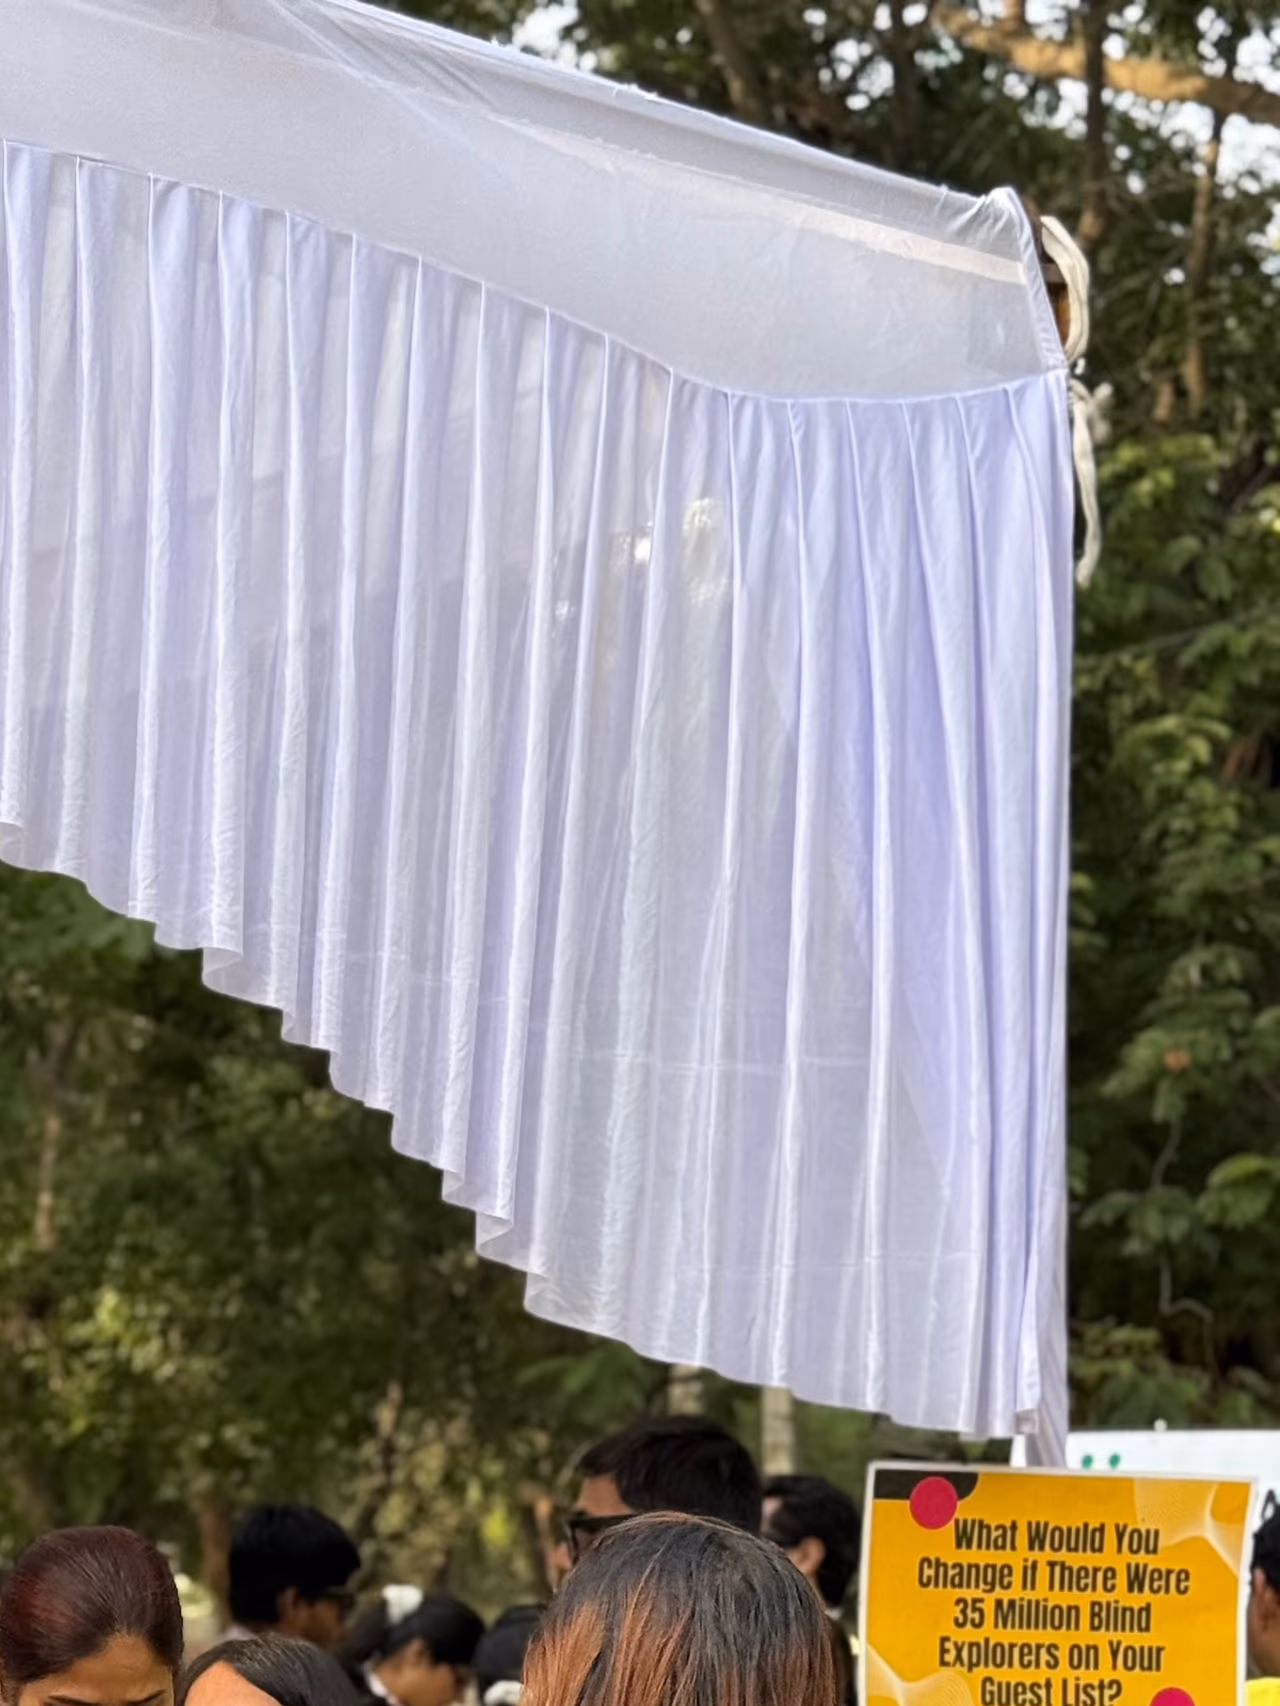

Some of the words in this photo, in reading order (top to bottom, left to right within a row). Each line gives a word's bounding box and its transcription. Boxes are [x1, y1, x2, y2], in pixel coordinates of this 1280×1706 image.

[953, 1518, 1018, 1551] What
[1026, 1520, 1106, 1554] Would
[1114, 1523, 1160, 1555] You
[918, 1557, 1013, 1592] Change
[1022, 1559, 1038, 1591] if
[1046, 1560, 1117, 1594] There
[1125, 1563, 1190, 1595] Were
[953, 1598, 985, 1629] 35
[994, 1598, 1080, 1632] Million
[1089, 1600, 1151, 1633] Blind
[939, 1636, 1059, 1672] Explorers
[1068, 1643, 1099, 1670] on
[1108, 1640, 1165, 1672] Your
